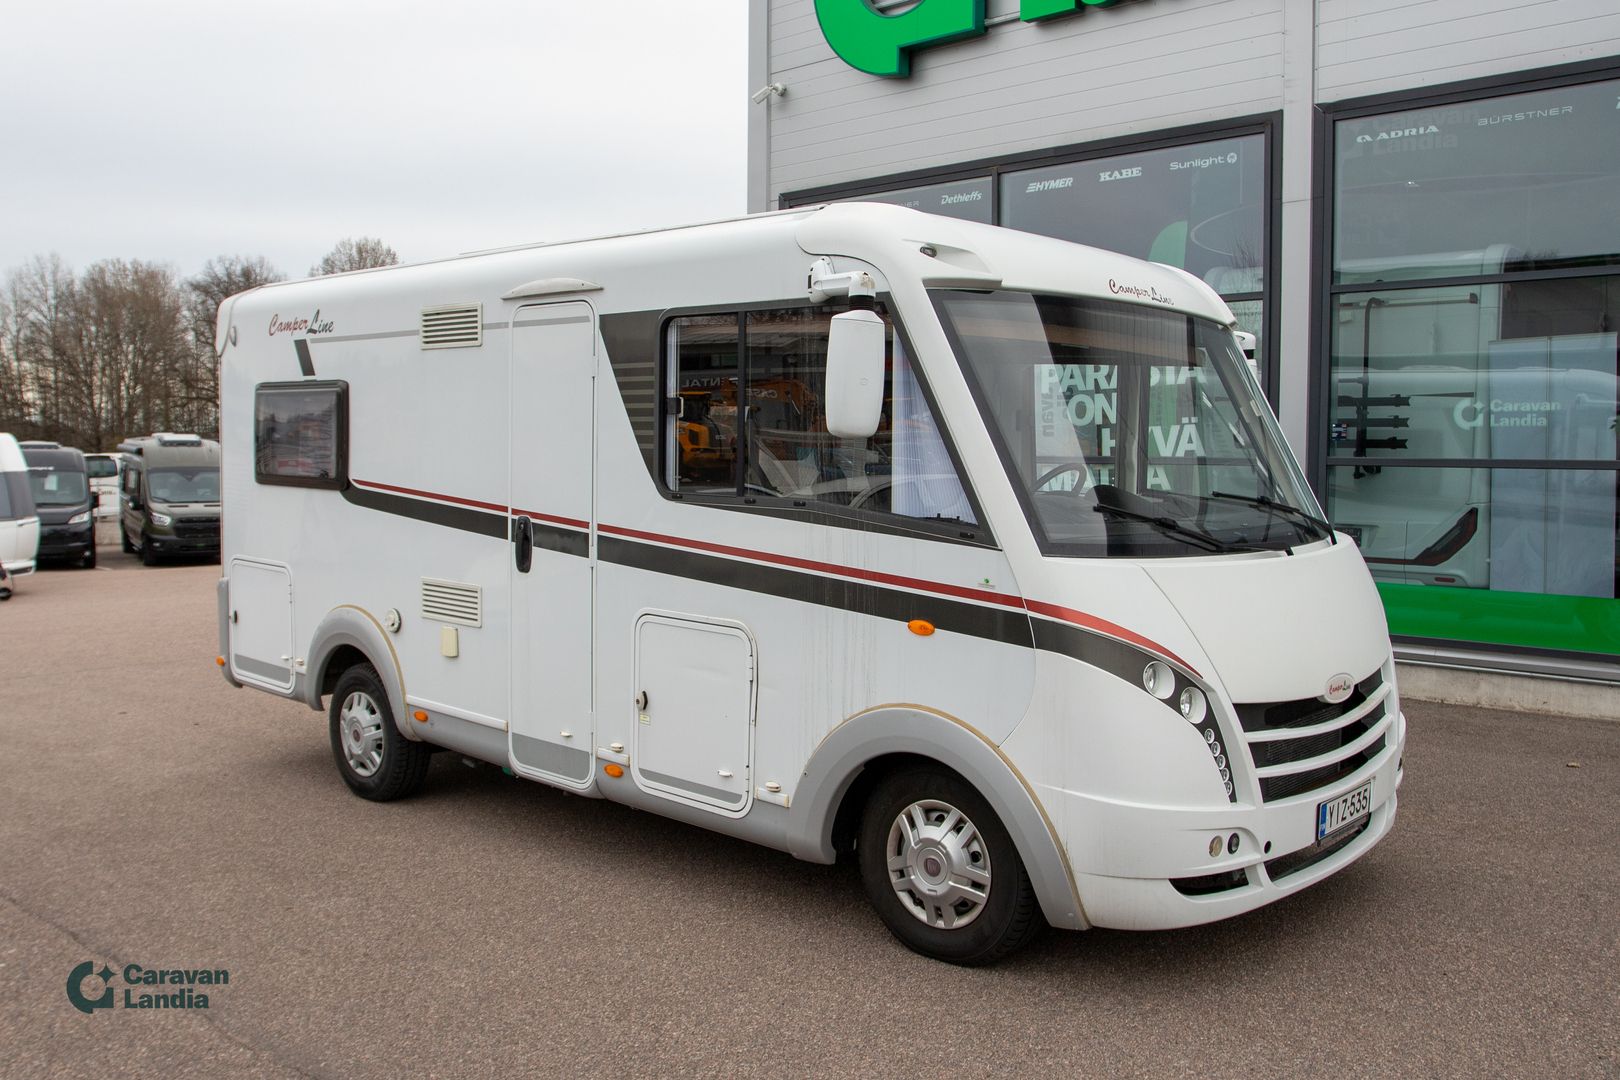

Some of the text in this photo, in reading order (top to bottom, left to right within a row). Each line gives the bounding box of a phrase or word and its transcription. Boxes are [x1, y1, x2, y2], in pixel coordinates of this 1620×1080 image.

[1376, 124, 1440, 141] ADRIA
[1169, 155, 1225, 170] Sunlight
[1099, 167, 1143, 182] KABE
[1034, 177, 1074, 192] HYMER
[941, 190, 983, 205] Dethleffs
[1489, 399, 1561, 413] Caravan
[1489, 413, 1548, 428] Landia
[1328, 787, 1369, 829] YIZ-535
